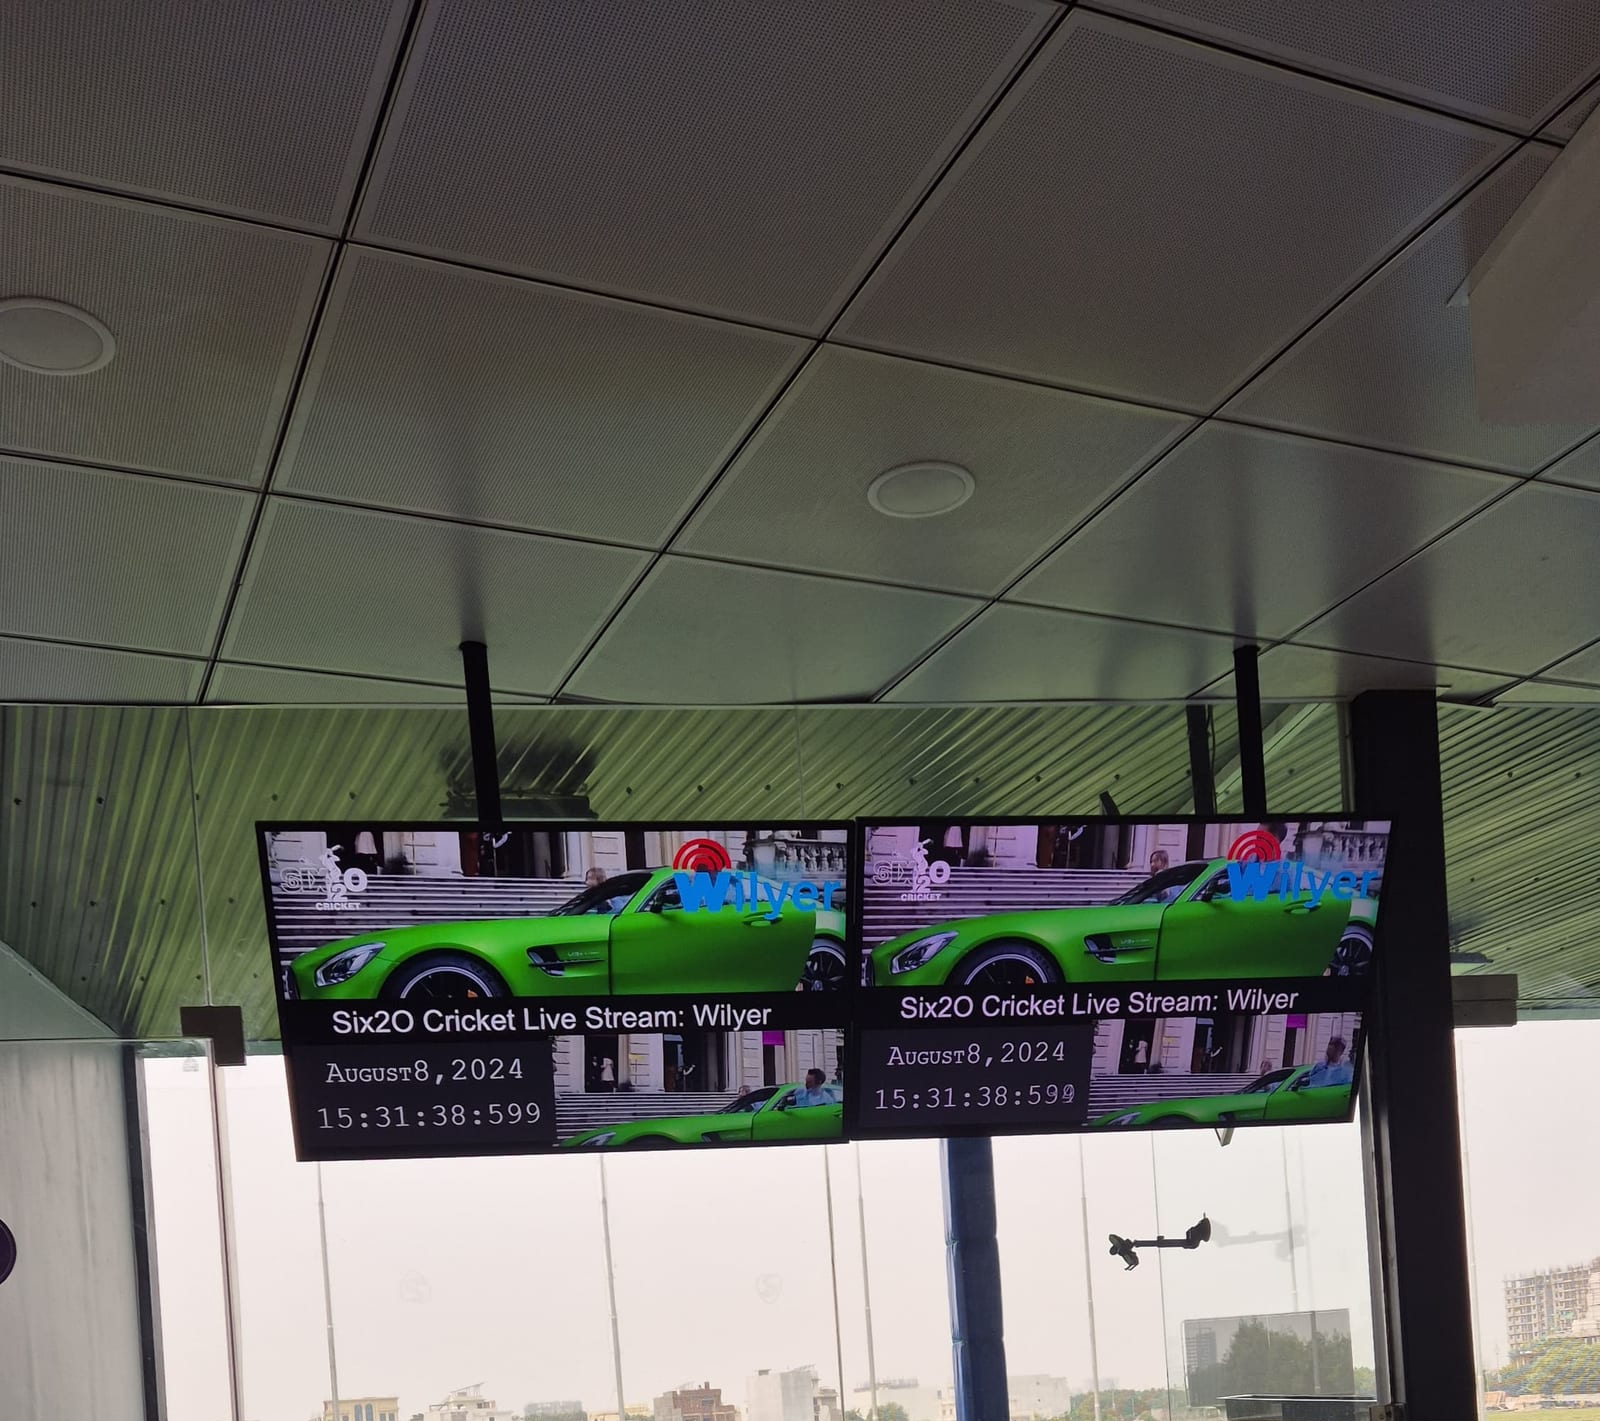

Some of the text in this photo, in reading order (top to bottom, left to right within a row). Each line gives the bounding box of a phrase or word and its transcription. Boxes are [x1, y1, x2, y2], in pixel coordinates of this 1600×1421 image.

[673, 871, 841, 921] Wilyer
[1226, 861, 1380, 910] Wilyer
[315, 902, 361, 911] CRICKET
[982, 994, 1065, 1017] Cricket
[1072, 992, 1120, 1015] Live
[1128, 991, 1218, 1014] Stream:
[1227, 988, 1299, 1015] Wilyer
[423, 1008, 516, 1032] Cricket
[524, 1007, 577, 1031] Live
[585, 1005, 684, 1030] Stream:
[692, 1003, 772, 1032] Wilyer
[317, 1102, 541, 1129] 15:31:38:599
